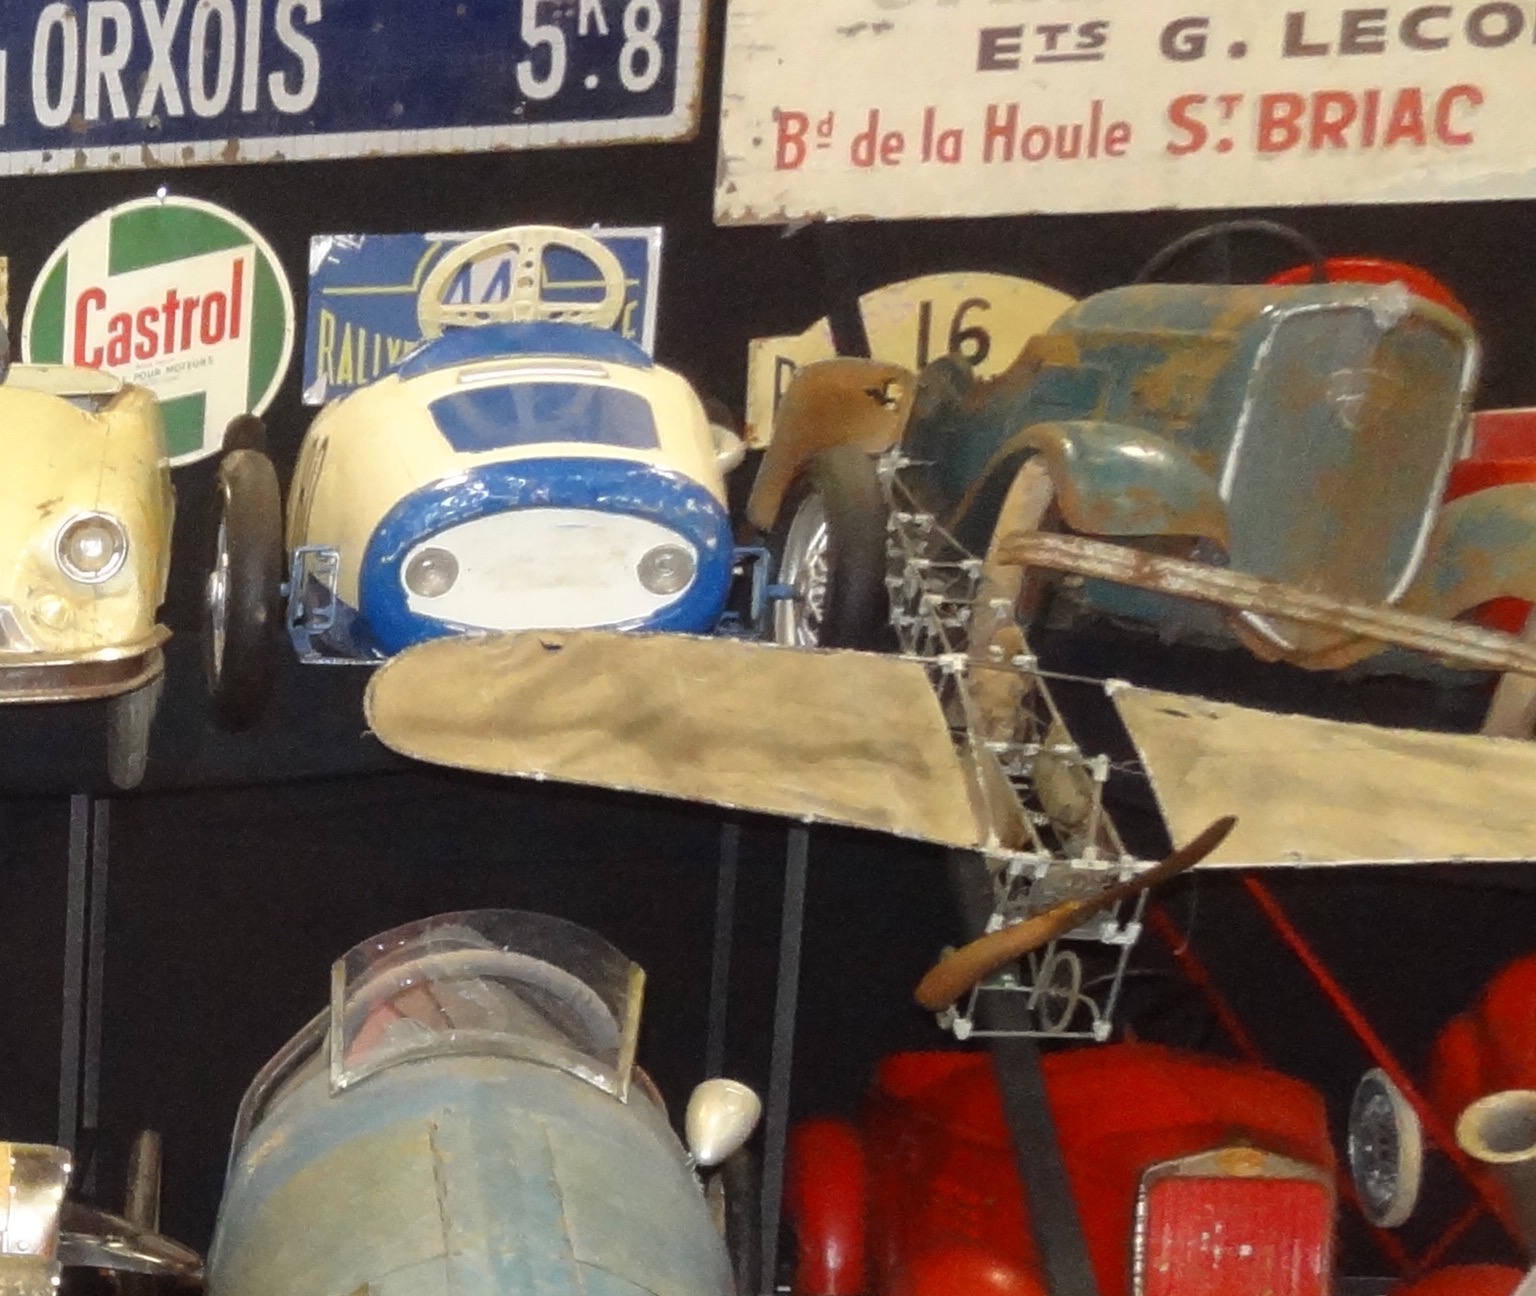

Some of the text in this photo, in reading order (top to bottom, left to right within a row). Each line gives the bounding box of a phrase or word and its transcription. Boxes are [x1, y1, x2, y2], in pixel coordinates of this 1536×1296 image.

[31, 0, 323, 128] ORXOIS
[1281, 1, 1536, 59] LECO
[850, 107, 906, 168] de
[921, 105, 964, 165] la
[982, 98, 1132, 164] Houle
[1256, 83, 1485, 153] BRIAC
[73, 257, 245, 371] Castrol
[917, 297, 991, 369] 16
